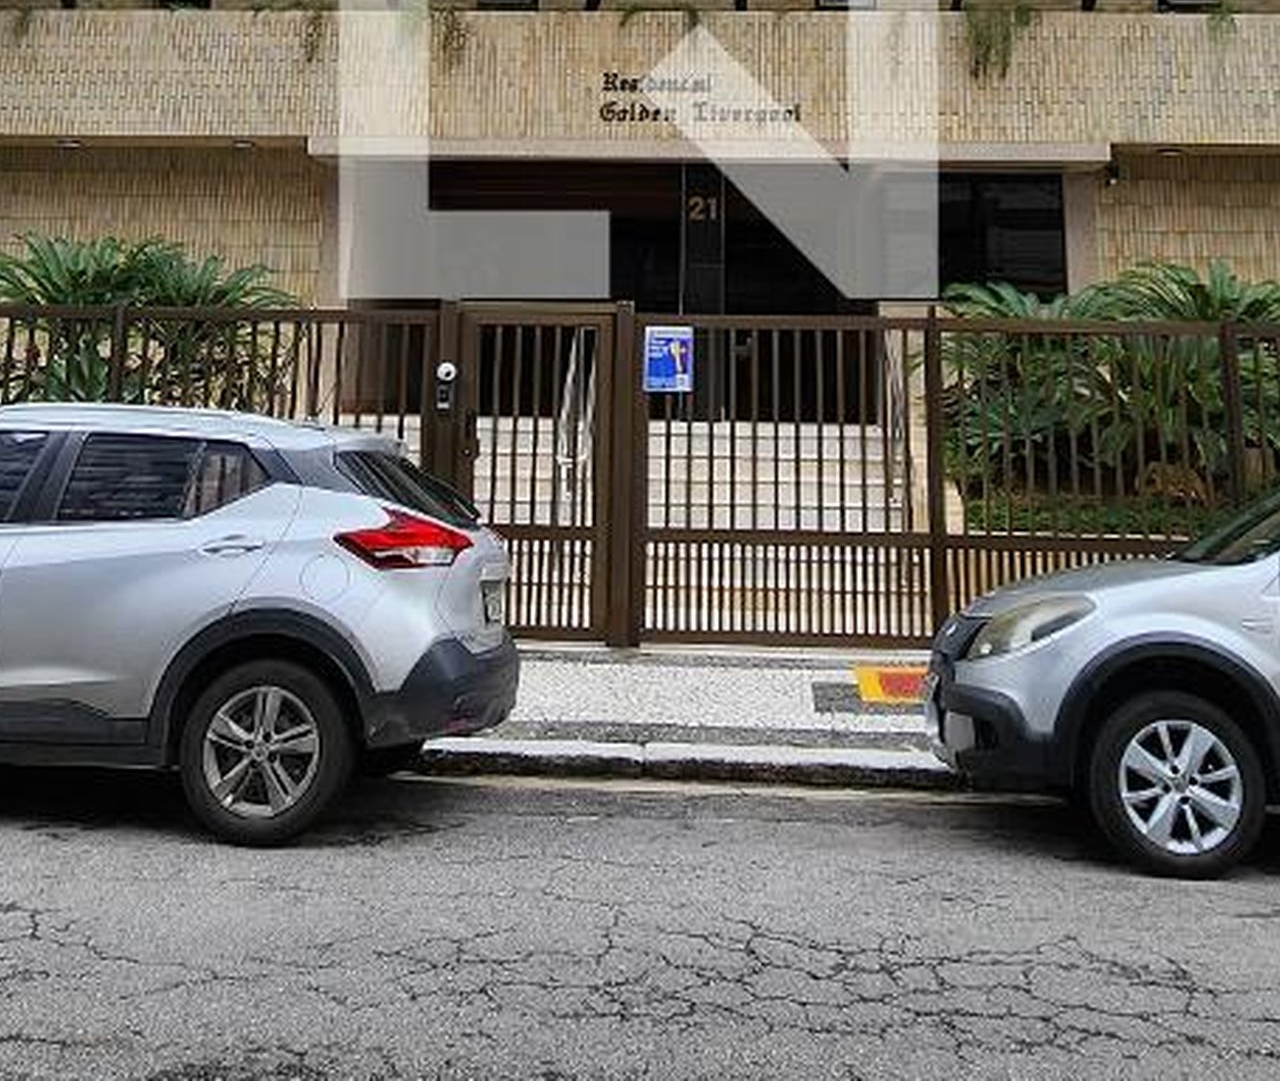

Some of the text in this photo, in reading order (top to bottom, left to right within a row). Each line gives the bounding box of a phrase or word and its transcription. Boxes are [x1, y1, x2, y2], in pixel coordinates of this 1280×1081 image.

[600, 101, 801, 126] Golden Liverpool
[688, 195, 718, 220] 21
